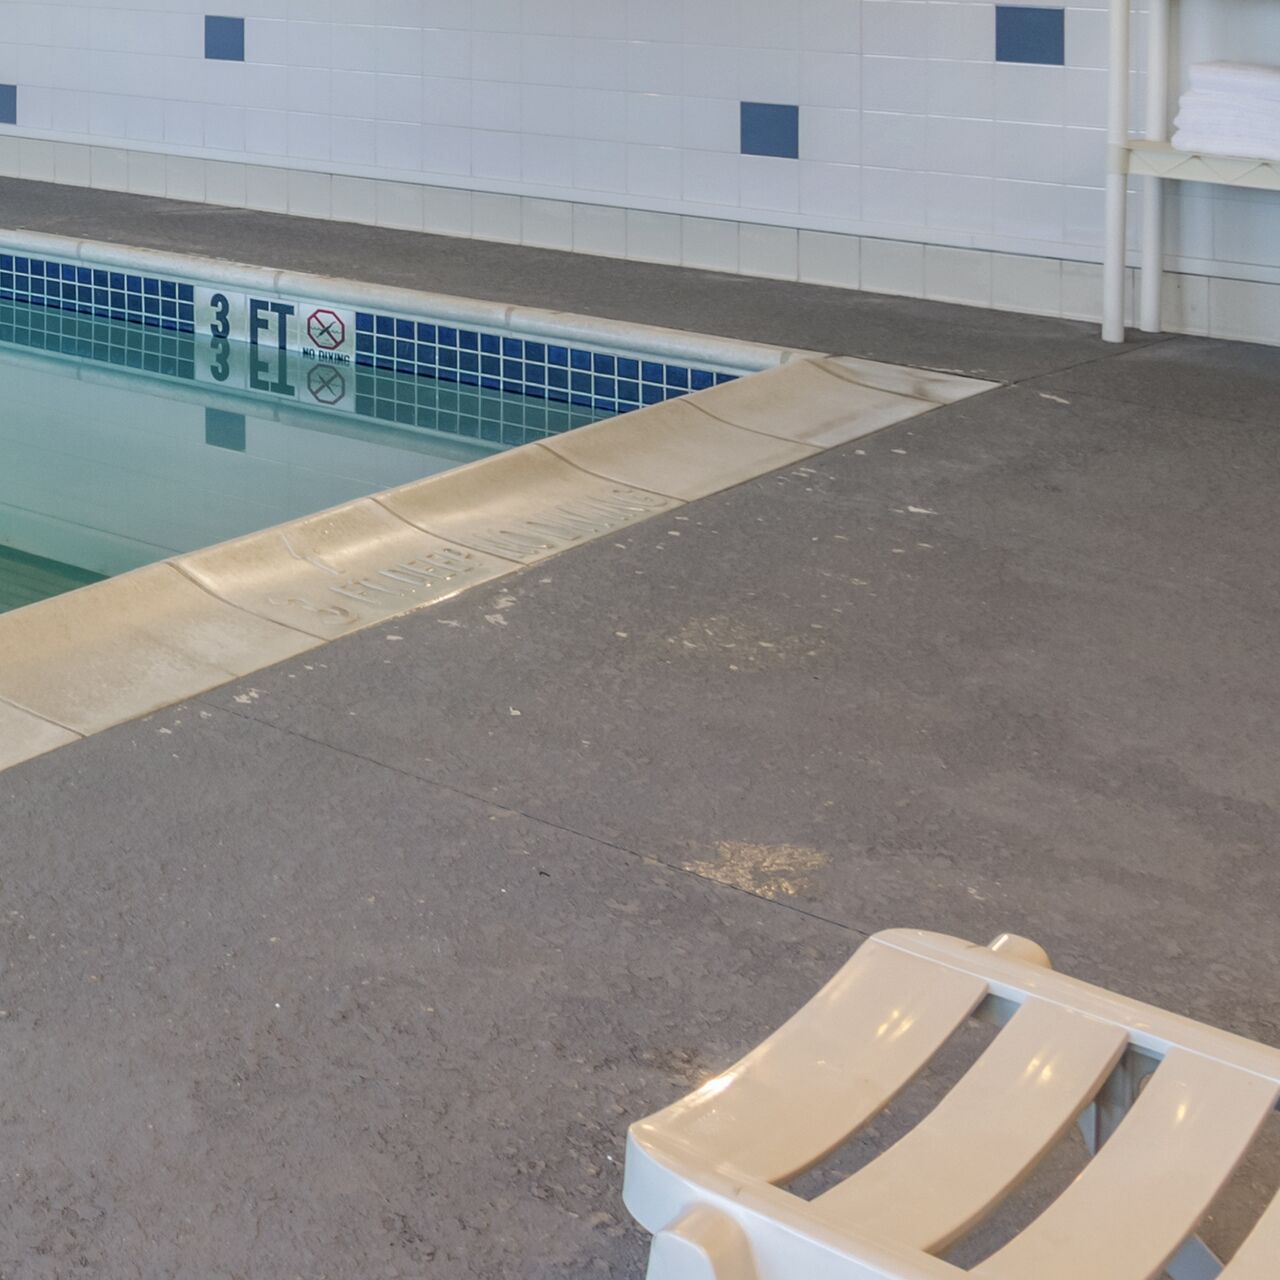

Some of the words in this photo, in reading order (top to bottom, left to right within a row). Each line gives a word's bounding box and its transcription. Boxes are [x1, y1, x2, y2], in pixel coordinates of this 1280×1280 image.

[210, 293, 230, 339] 3
[249, 298, 295, 350] FT
[302, 346, 315, 358] NO
[470, 528, 555, 560] NO
[520, 489, 668, 542] DIVING
